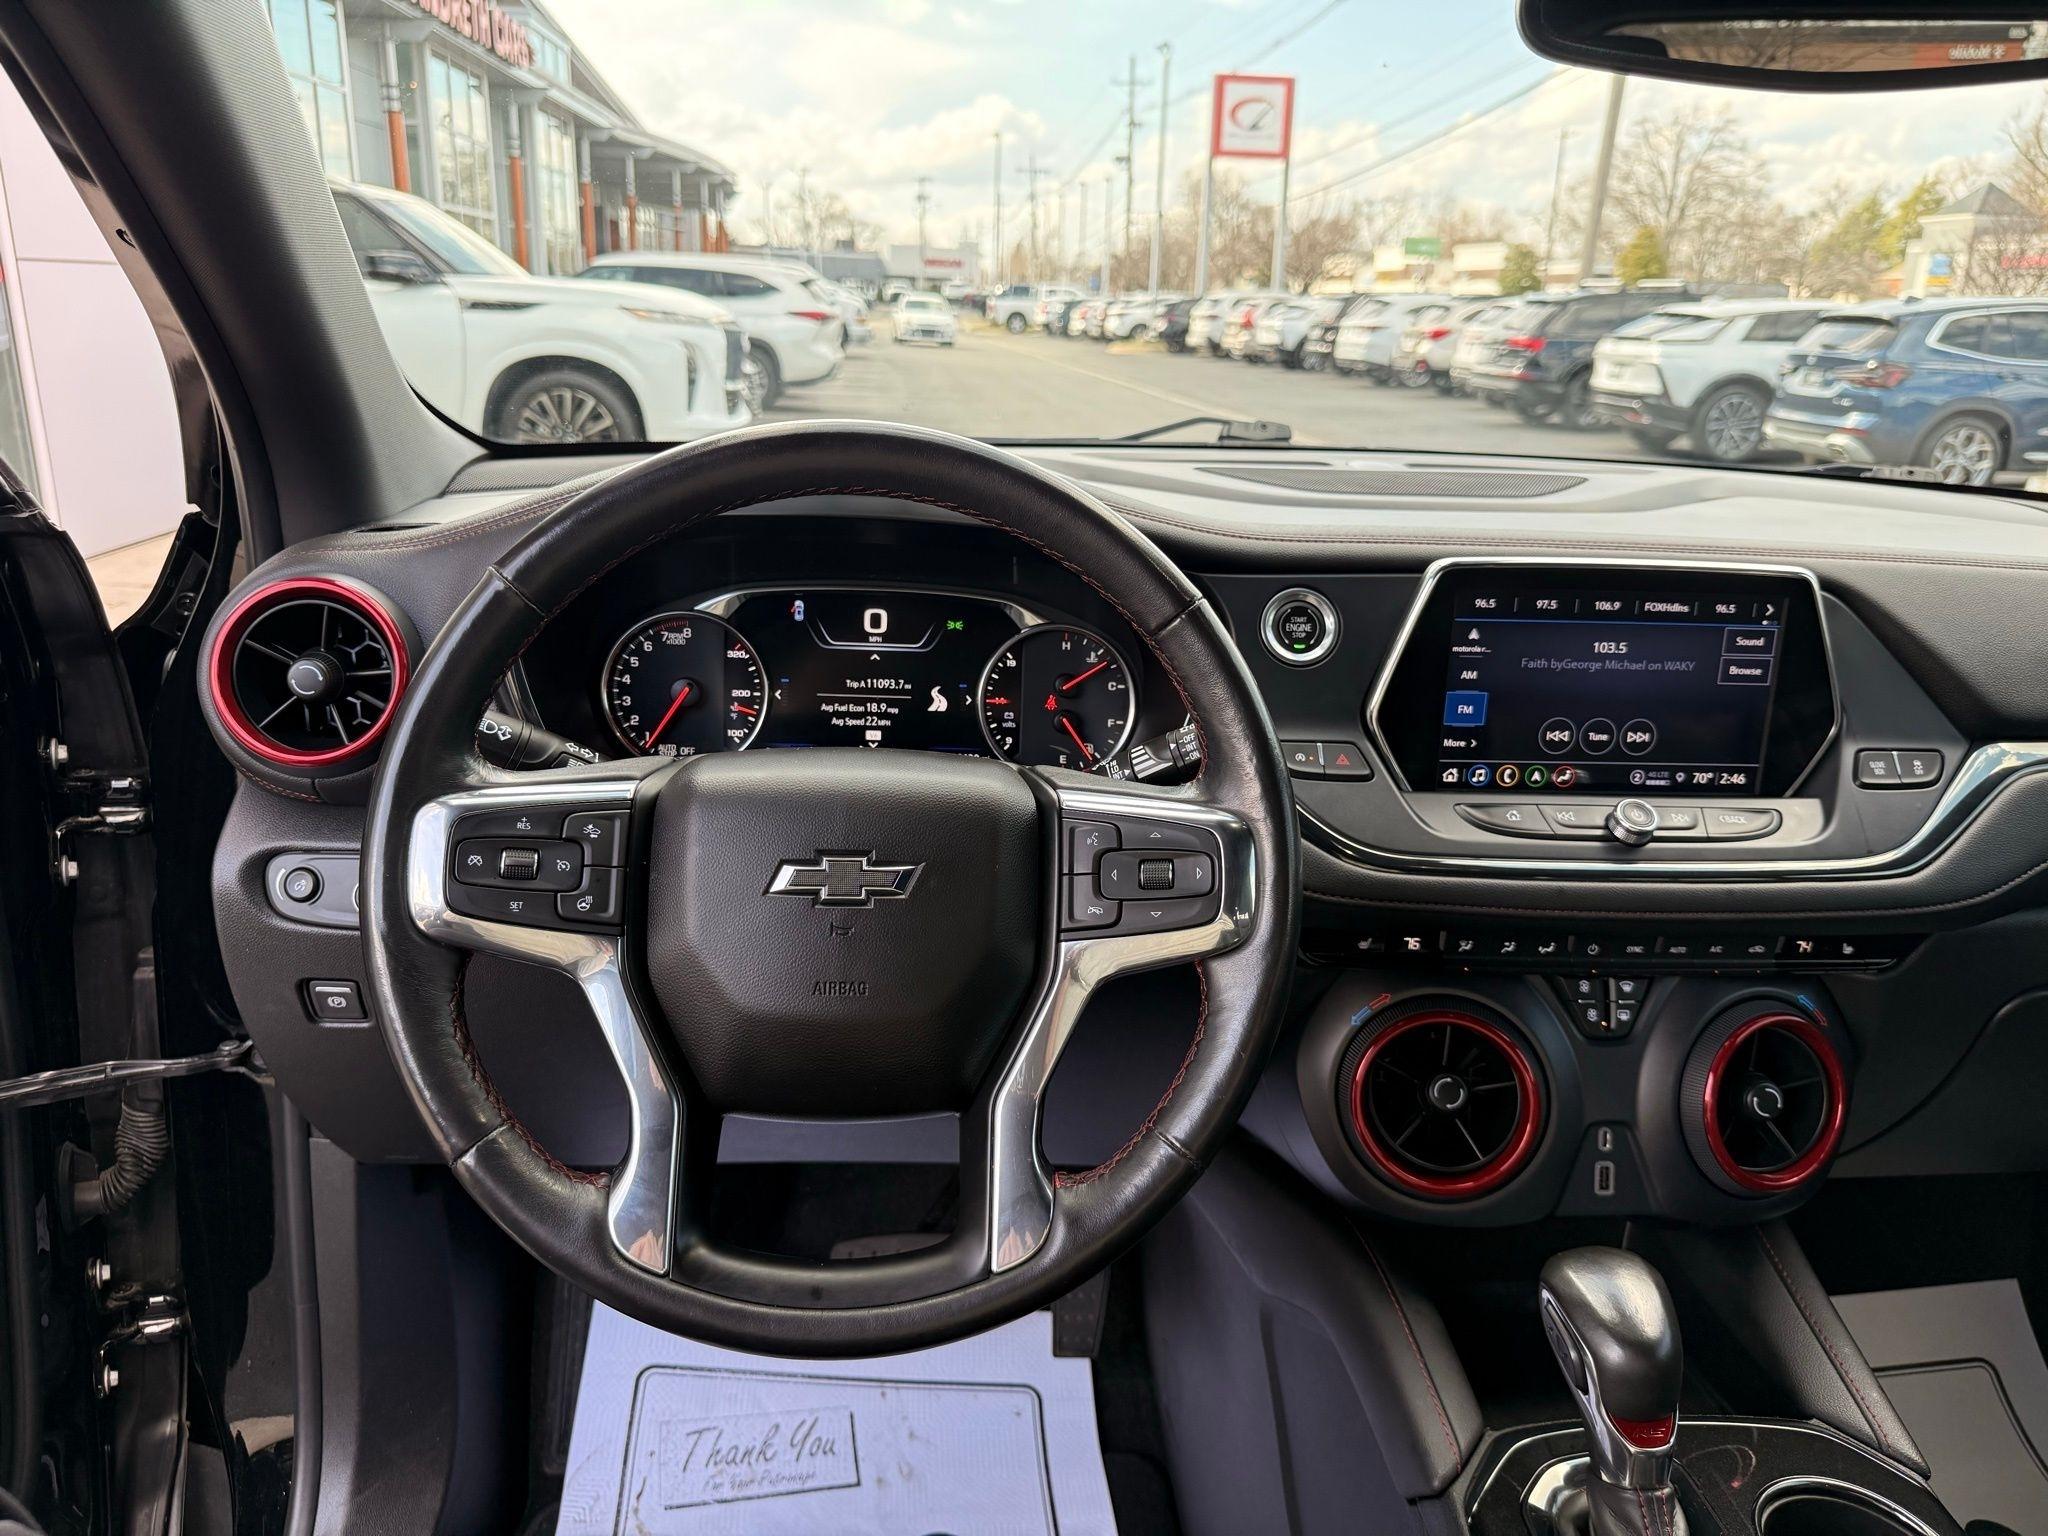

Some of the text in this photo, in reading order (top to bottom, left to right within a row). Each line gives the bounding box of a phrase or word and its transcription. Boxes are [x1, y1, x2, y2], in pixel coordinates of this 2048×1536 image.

[1474, 598, 1496, 608] 96.5
[1536, 600, 1558, 610] 97.5
[1594, 601, 1622, 611] 106.9
[1715, 604, 1736, 614] 96.5
[863, 608, 888, 634] 0
[683, 627, 692, 638] 8
[1285, 623, 1313, 632] ENGINE
[643, 641, 653, 652] 6
[1062, 642, 1071, 650] H
[1735, 636, 1765, 647] Sound
[1592, 641, 1629, 654] 103.5
[727, 650, 746, 659] 320
[629, 656, 640, 668] 5
[1006, 659, 1017, 668] 19
[1521, 658, 1548, 669] Faith
[1605, 659, 1646, 671] Michael
[1647, 662, 1662, 671] on
[1663, 660, 1696, 671] WAKY
[1460, 670, 1478, 680] AM
[1728, 665, 1763, 676] Browse
[621, 674, 632, 685] 4
[845, 679, 860, 690] Trip
[860, 680, 866, 688] A
[866, 679, 905, 690] 11093.7
[1107, 682, 1117, 691] C
[731, 689, 751, 698] 200
[621, 696, 632, 706] 3
[820, 703, 835, 713] Avg
[836, 703, 848, 713] Fuel
[849, 703, 865, 713] Econ
[866, 702, 887, 713] 18.9
[1457, 704, 1474, 714] FM
[630, 715, 640, 726] 2
[831, 717, 844, 727] Avg
[845, 717, 865, 727] Speed
[865, 716, 878, 726] 22
[1107, 718, 1116, 728] F
[727, 729, 744, 737] 100
[1183, 732, 1196, 743] OFF
[1587, 732, 1609, 741] Tune
[1005, 736, 1013, 745] 9
[1443, 738, 1467, 748] More
[658, 743, 696, 756] AUTO OFF
[1185, 742, 1197, 752] INT
[1059, 754, 1067, 764] E
[1692, 772, 1715, 784] 70°
[1719, 772, 1746, 785] 2:46
[516, 821, 531, 831] RES
[509, 901, 524, 909] SET
[812, 980, 869, 997] AIRBAG
[682, 1415, 836, 1473] Thank You
